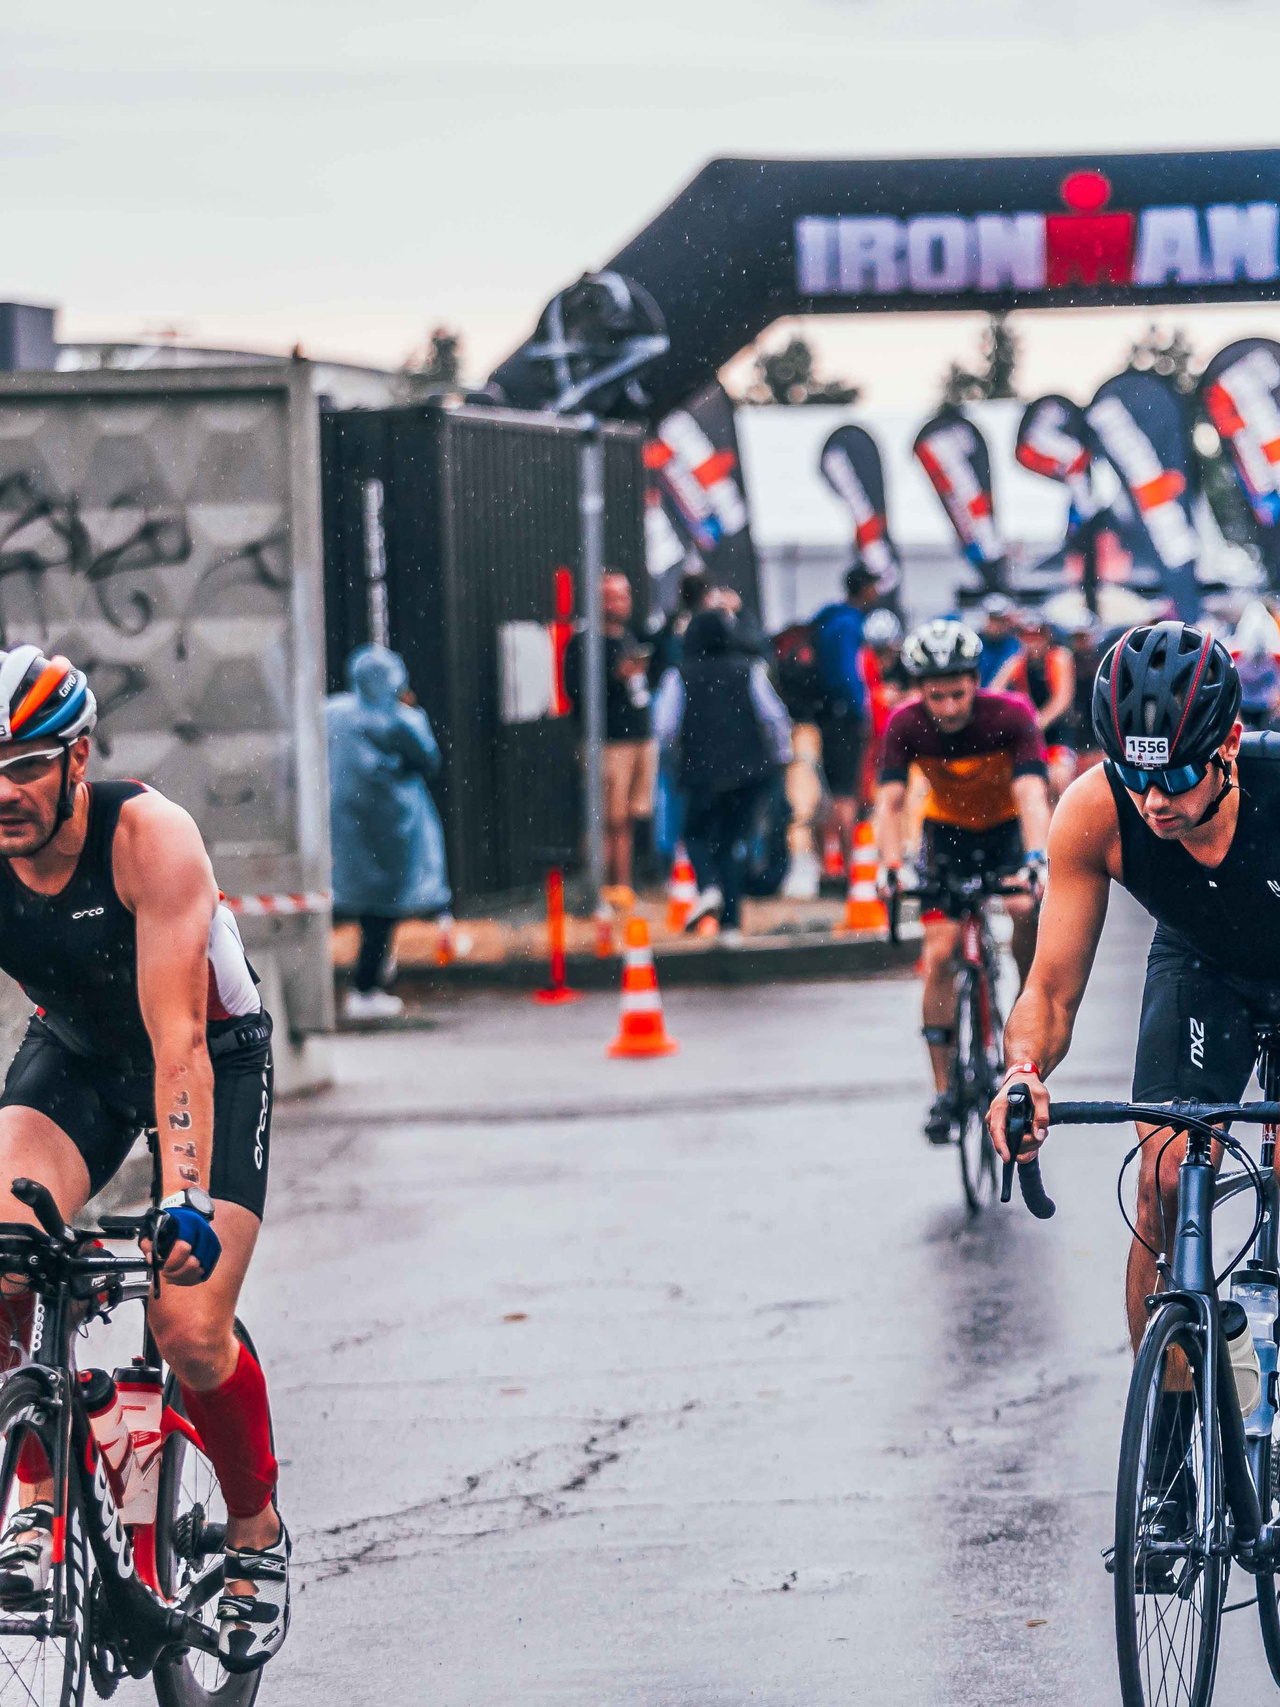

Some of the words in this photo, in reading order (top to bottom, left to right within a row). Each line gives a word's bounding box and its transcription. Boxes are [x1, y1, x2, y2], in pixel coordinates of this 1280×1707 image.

[59, 674, 77, 698] GIRO
[1128, 739, 1167, 754] 1556
[72, 907, 104, 919] orca
[1189, 1016, 1205, 1070] 2XU
